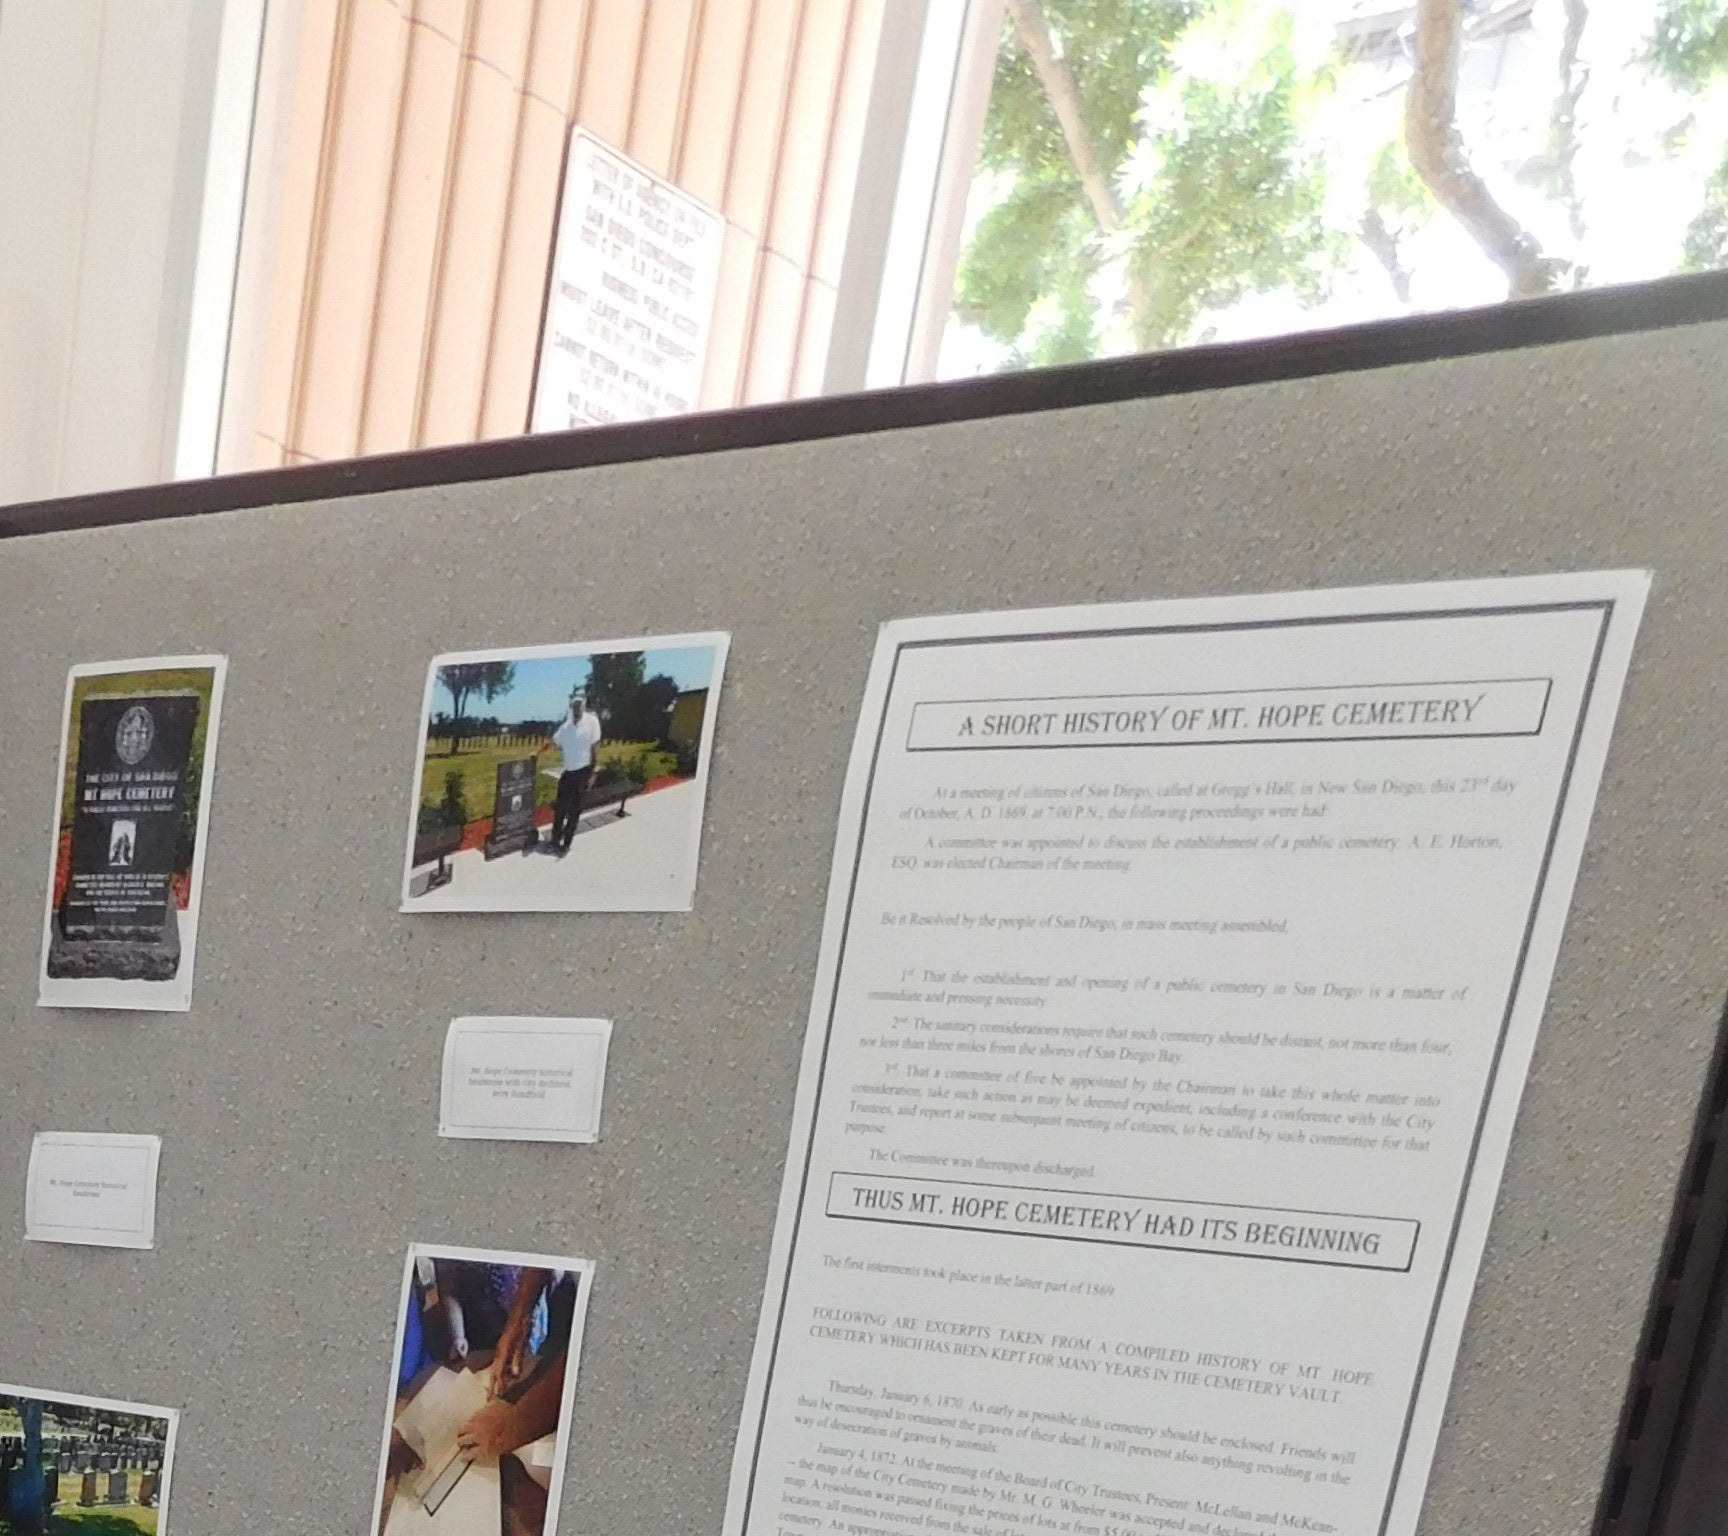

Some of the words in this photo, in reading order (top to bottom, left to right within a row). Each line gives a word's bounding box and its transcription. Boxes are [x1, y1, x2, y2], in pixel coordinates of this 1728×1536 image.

[958, 716, 973, 736] A
[981, 713, 1058, 735] SHORT
[1063, 706, 1169, 733] HISTORY
[1171, 708, 1205, 732] OF
[1208, 707, 1248, 731] MT.
[1258, 703, 1326, 729] HOPE
[1331, 695, 1485, 727] CEMETERY
[853, 1187, 904, 1211] THUS
[909, 1193, 943, 1214] MT.
[951, 1196, 1009, 1220] HOPE
[1015, 1202, 1141, 1231] CEMETERY
[1144, 1213, 1194, 1237] HAD
[1201, 1218, 1238, 1241] ITS
[1244, 1222, 1381, 1254] BEGINNING
[809, 1325, 874, 1344] CEMETERY
[880, 1334, 923, 1350] WHICH
[924, 1339, 950, 1354] HAS
[953, 1343, 989, 1358] BEEN
[991, 1348, 1026, 1363] KEPT
[1027, 1352, 1055, 1367] FOR
[1057, 1356, 1102, 1373] MANY
[1105, 1362, 1151, 1379] YEARS
[1153, 1368, 1169, 1381] IN
[1173, 1370, 1200, 1385] THE
[1203, 1374, 1285, 1396] CEMETERY
[812, 1306, 887, 1326] FOLLOWING
[893, 1317, 919, 1330] ARE
[925, 1320, 991, 1339] EXCERPTS
[999, 1328, 1045, 1345] TAKEN
[1051, 1334, 1091, 1351] FROM
[1098, 1341, 1107, 1354] A
[1115, 1342, 1190, 1363] COMPILED
[1196, 1352, 1262, 1373] HISTORY
[1269, 1361, 1289, 1376] OF
[1331, 1368, 1374, 1386] HOPE
